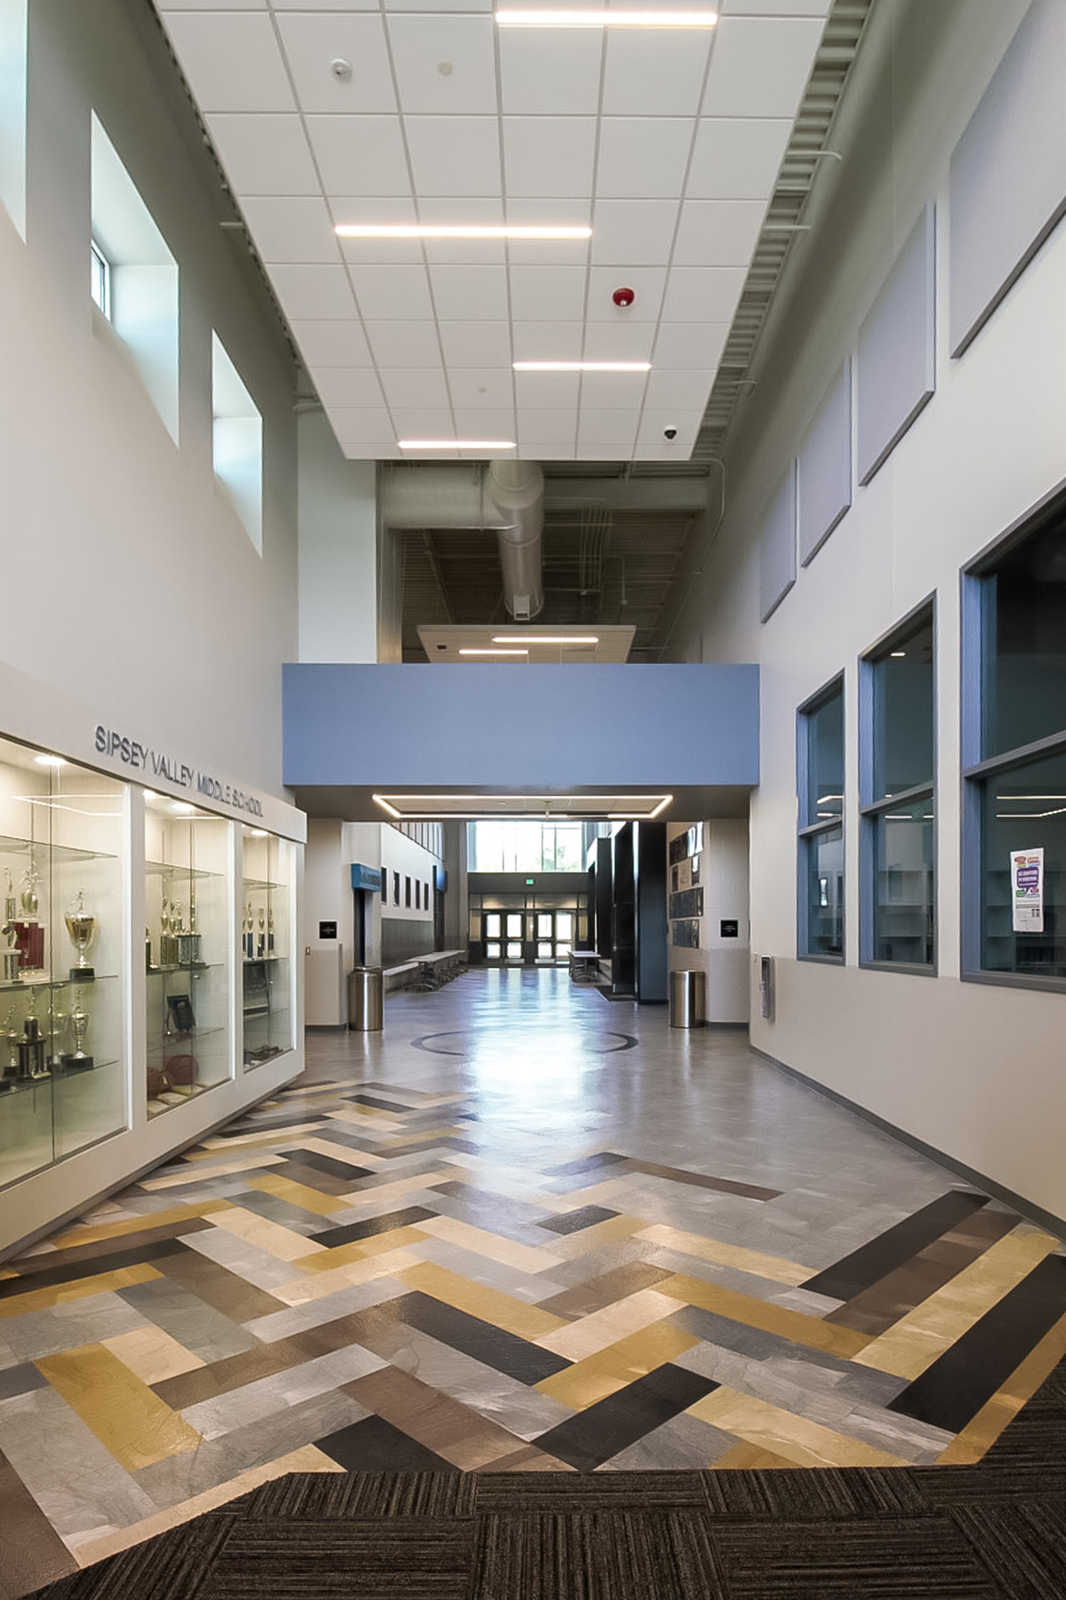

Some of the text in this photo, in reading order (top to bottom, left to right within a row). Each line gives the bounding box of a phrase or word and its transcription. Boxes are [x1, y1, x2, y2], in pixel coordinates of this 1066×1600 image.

[95, 725, 263, 818] SIPSEY VALLEY MIDDLE SCHOOL
